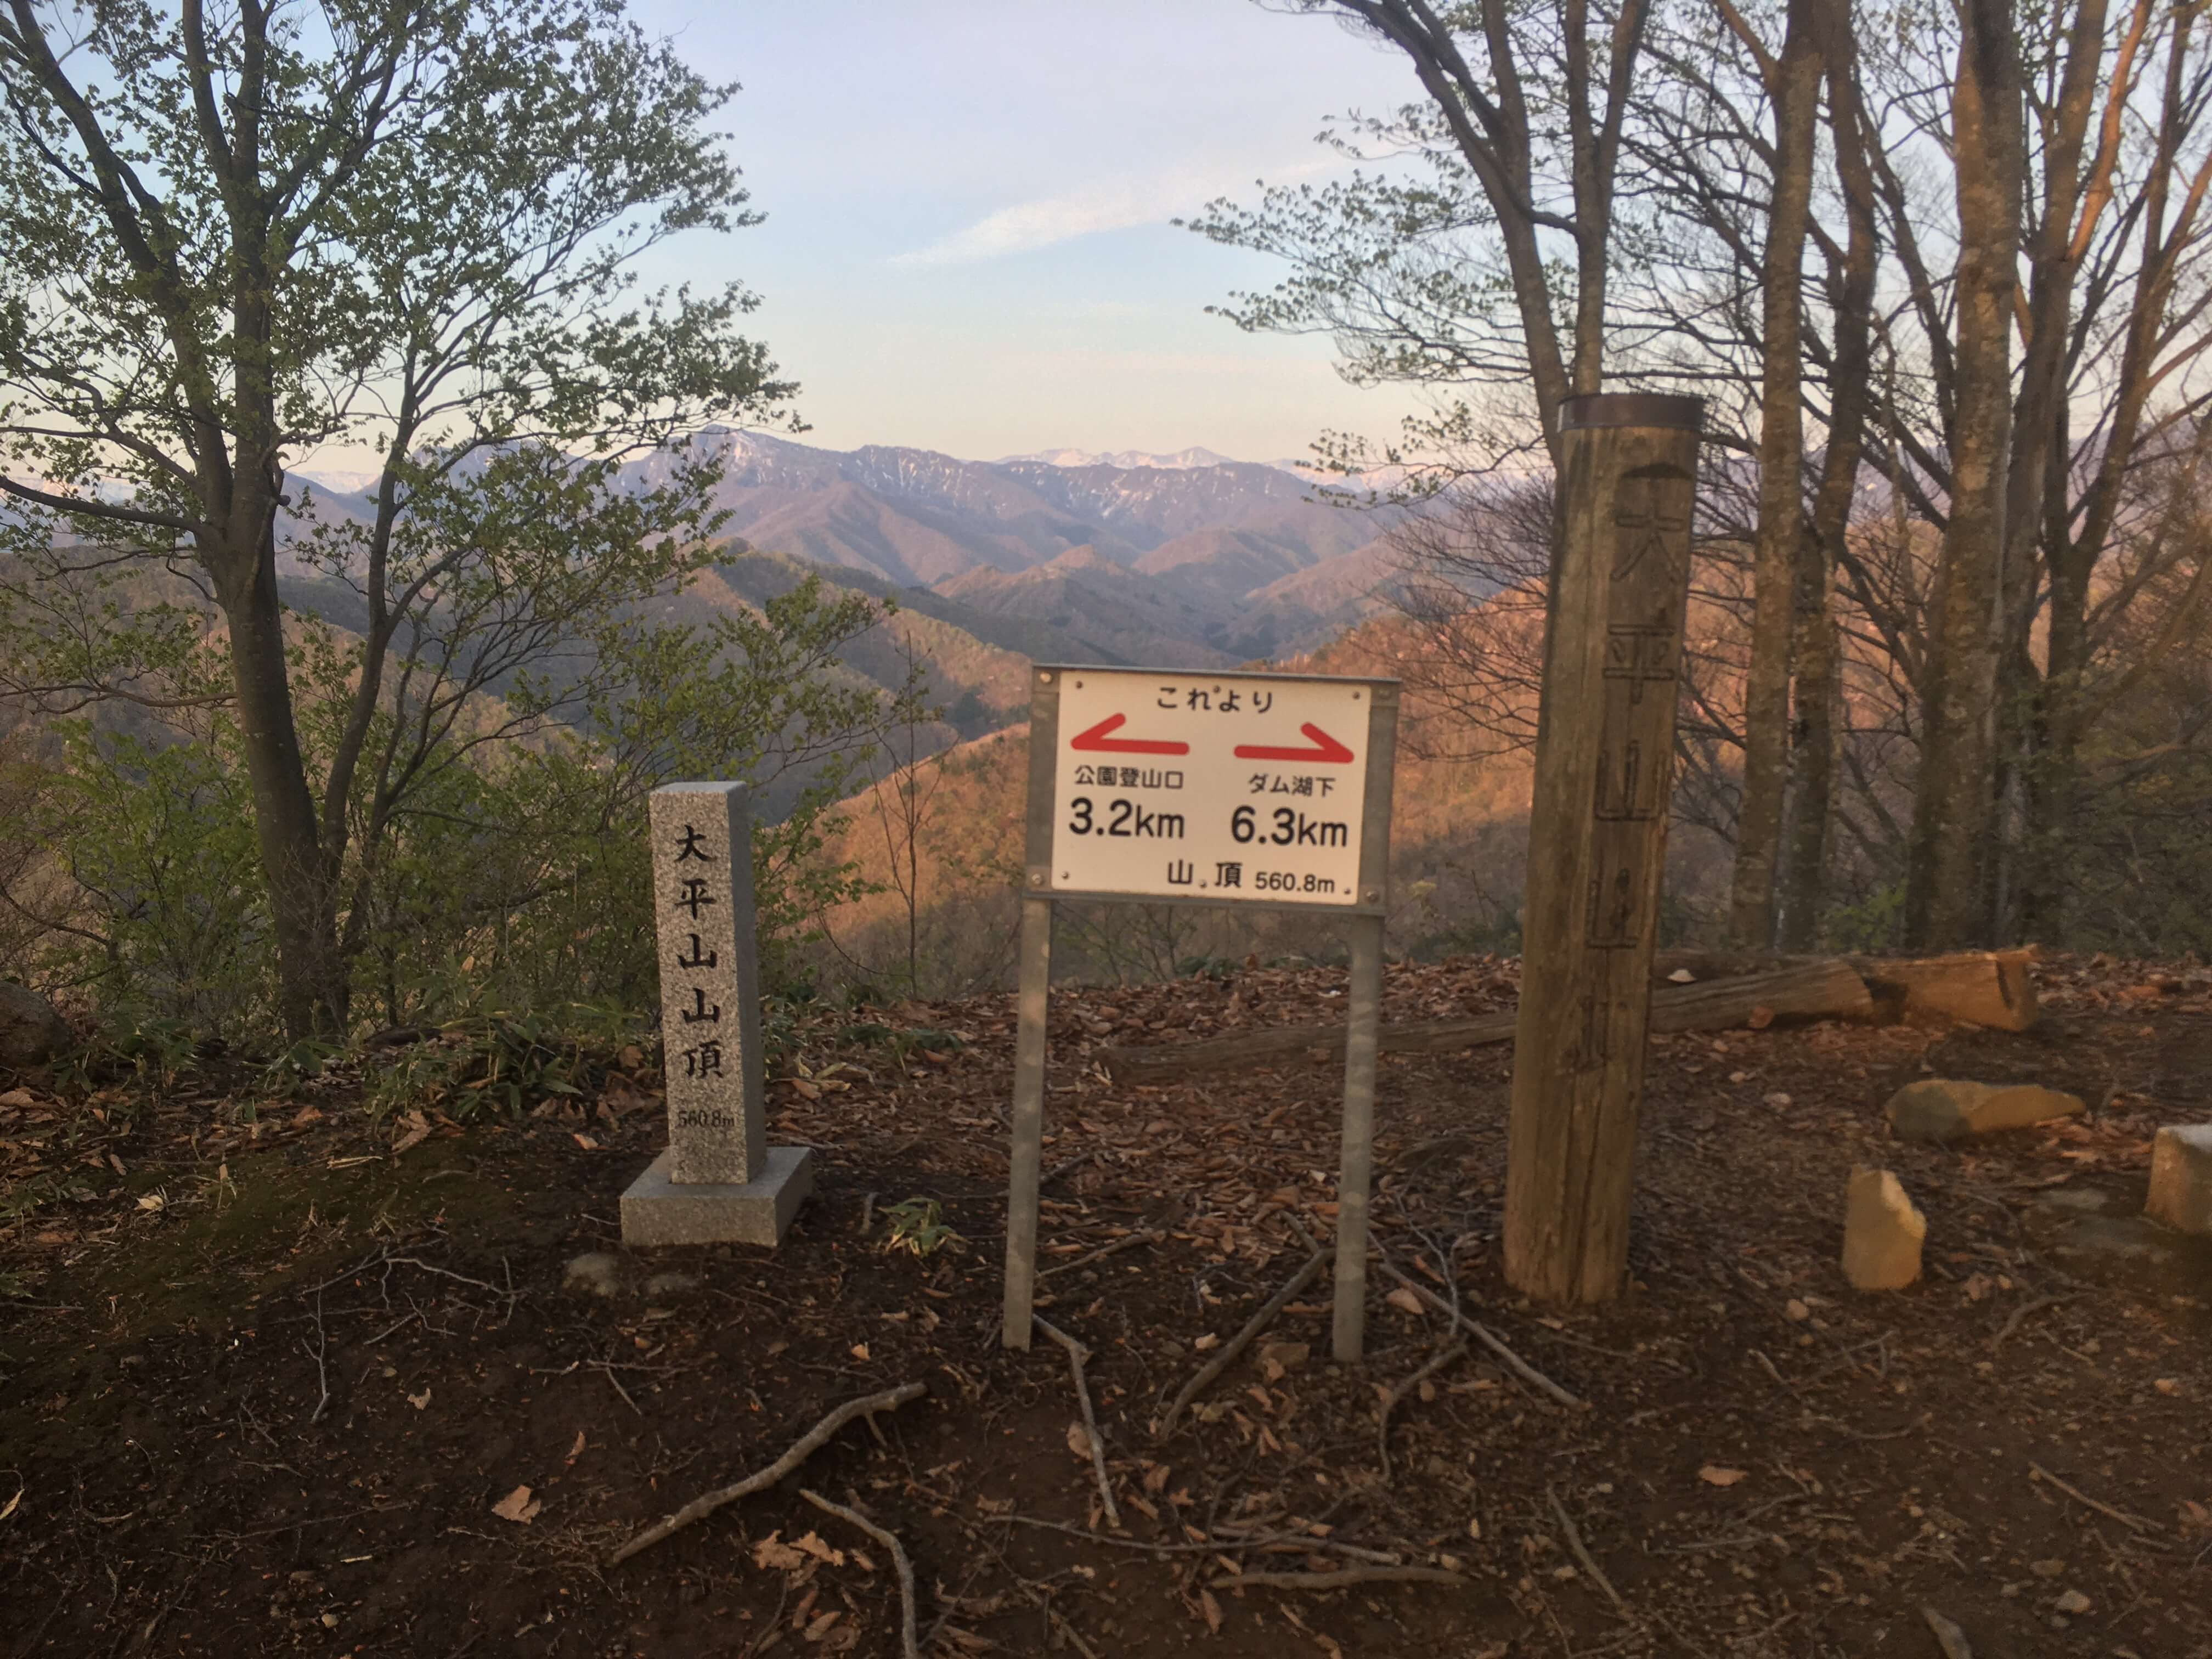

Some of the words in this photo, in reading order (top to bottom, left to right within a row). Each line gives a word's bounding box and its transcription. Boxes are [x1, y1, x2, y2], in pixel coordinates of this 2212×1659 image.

[1156, 686, 1273, 713] これより
[1074, 764, 1184, 789] 公園登山口
[1249, 773, 1337, 798] ダム湖下
[1068, 797, 1186, 839] 3.2km
[1231, 805, 1348, 848] 6.3km
[1255, 871, 1335, 894] 560.8m
[674, 824, 724, 1080] 大平山山頂
[676, 1109, 736, 1128] 560.8m
